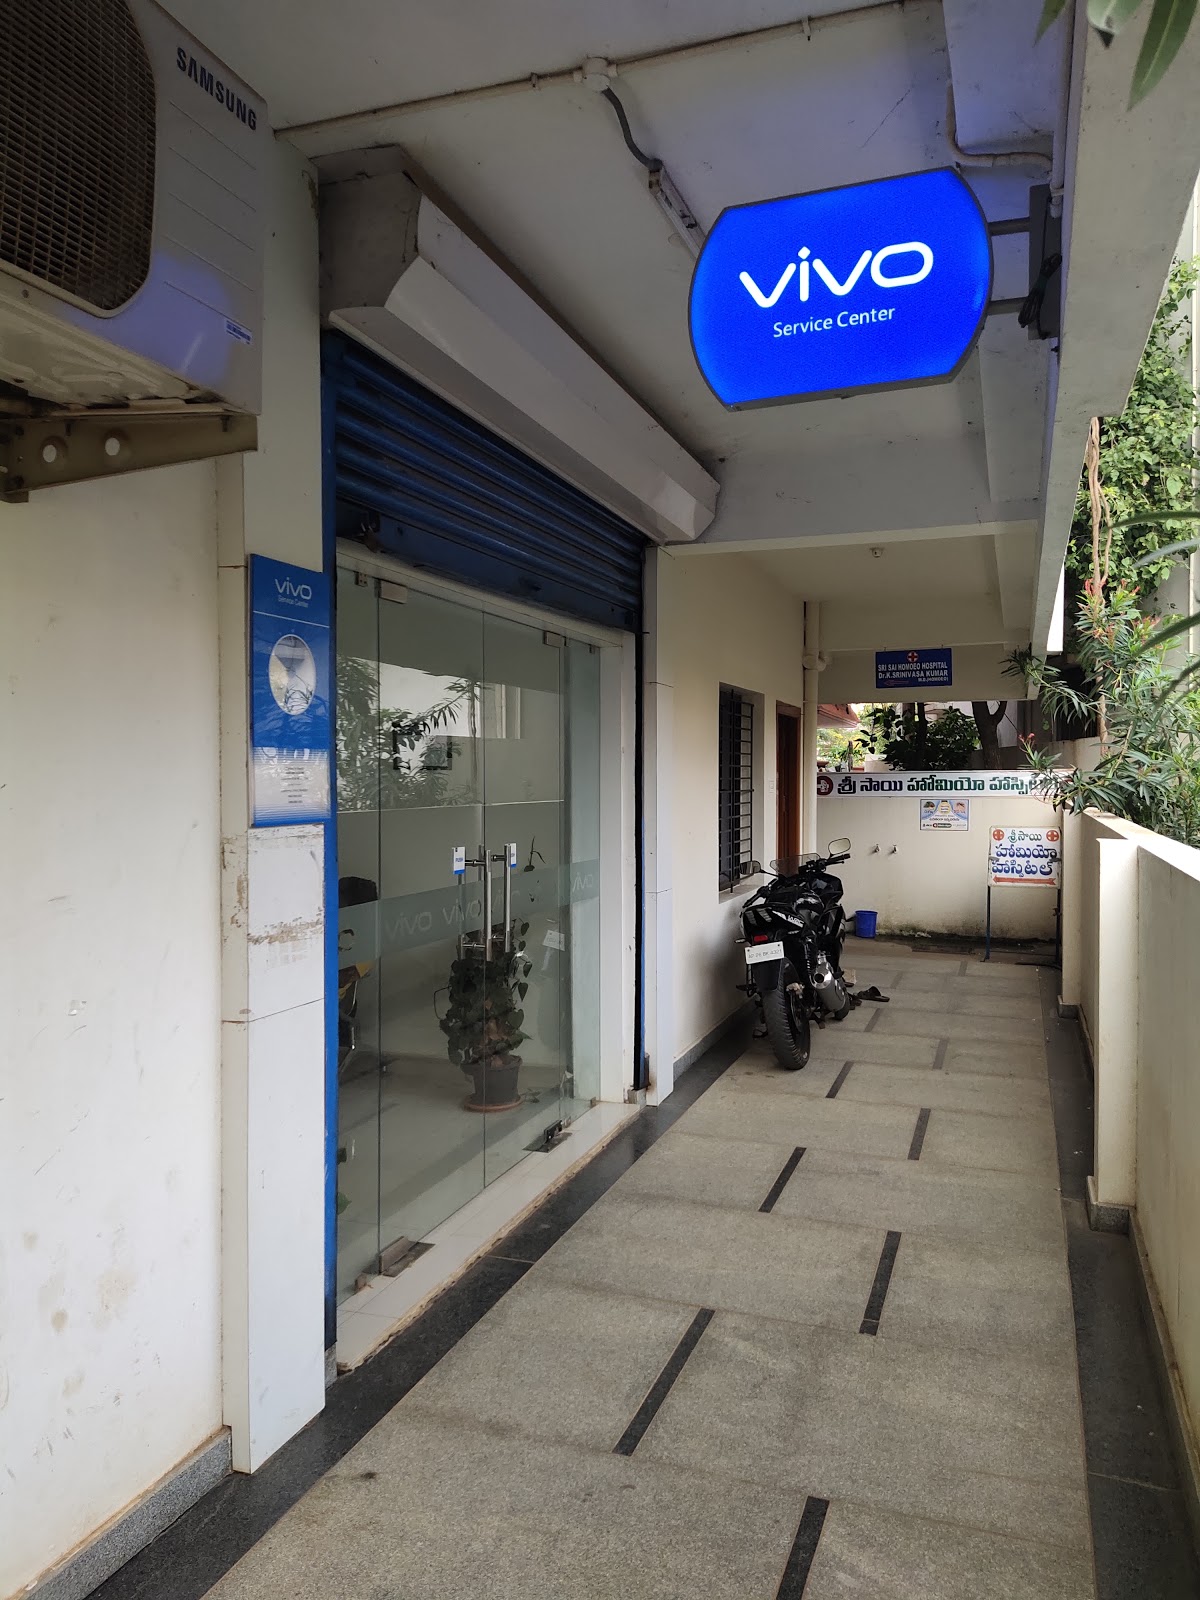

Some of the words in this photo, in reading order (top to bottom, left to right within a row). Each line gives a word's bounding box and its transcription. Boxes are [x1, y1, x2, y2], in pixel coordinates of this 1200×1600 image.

[176, 46, 258, 132] SAMSUNG
[739, 241, 934, 309] vivo
[772, 316, 833, 338] Service
[837, 307, 896, 328] Center
[275, 577, 312, 600] vivo
[837, 776, 856, 795] శ్రీ
[860, 777, 903, 792] సాయి
[907, 774, 985, 792] హోమియో
[995, 843, 1057, 859] హోమియో
[385, 911, 432, 942] vivo
[442, 898, 482, 926] vivo
